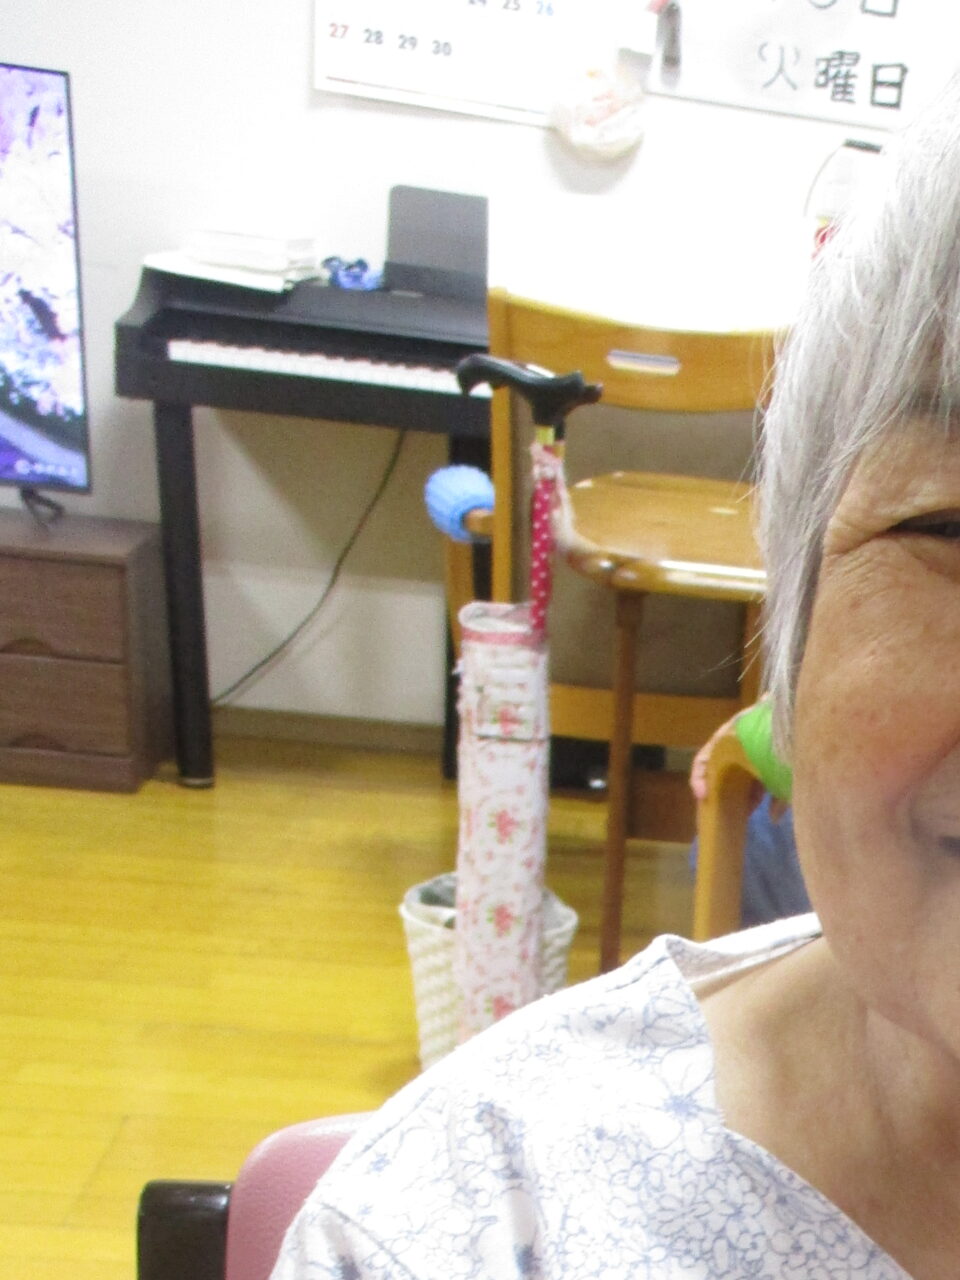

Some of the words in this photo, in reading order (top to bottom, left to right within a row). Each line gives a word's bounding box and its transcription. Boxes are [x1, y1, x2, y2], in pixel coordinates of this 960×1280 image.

[535, 0, 555, 17] 26
[328, 22, 350, 40] 27
[362, 28, 384, 46] 28
[397, 33, 418, 52] 29
[431, 39, 453, 57] 30
[757, 42, 909, 110] 火曜日
